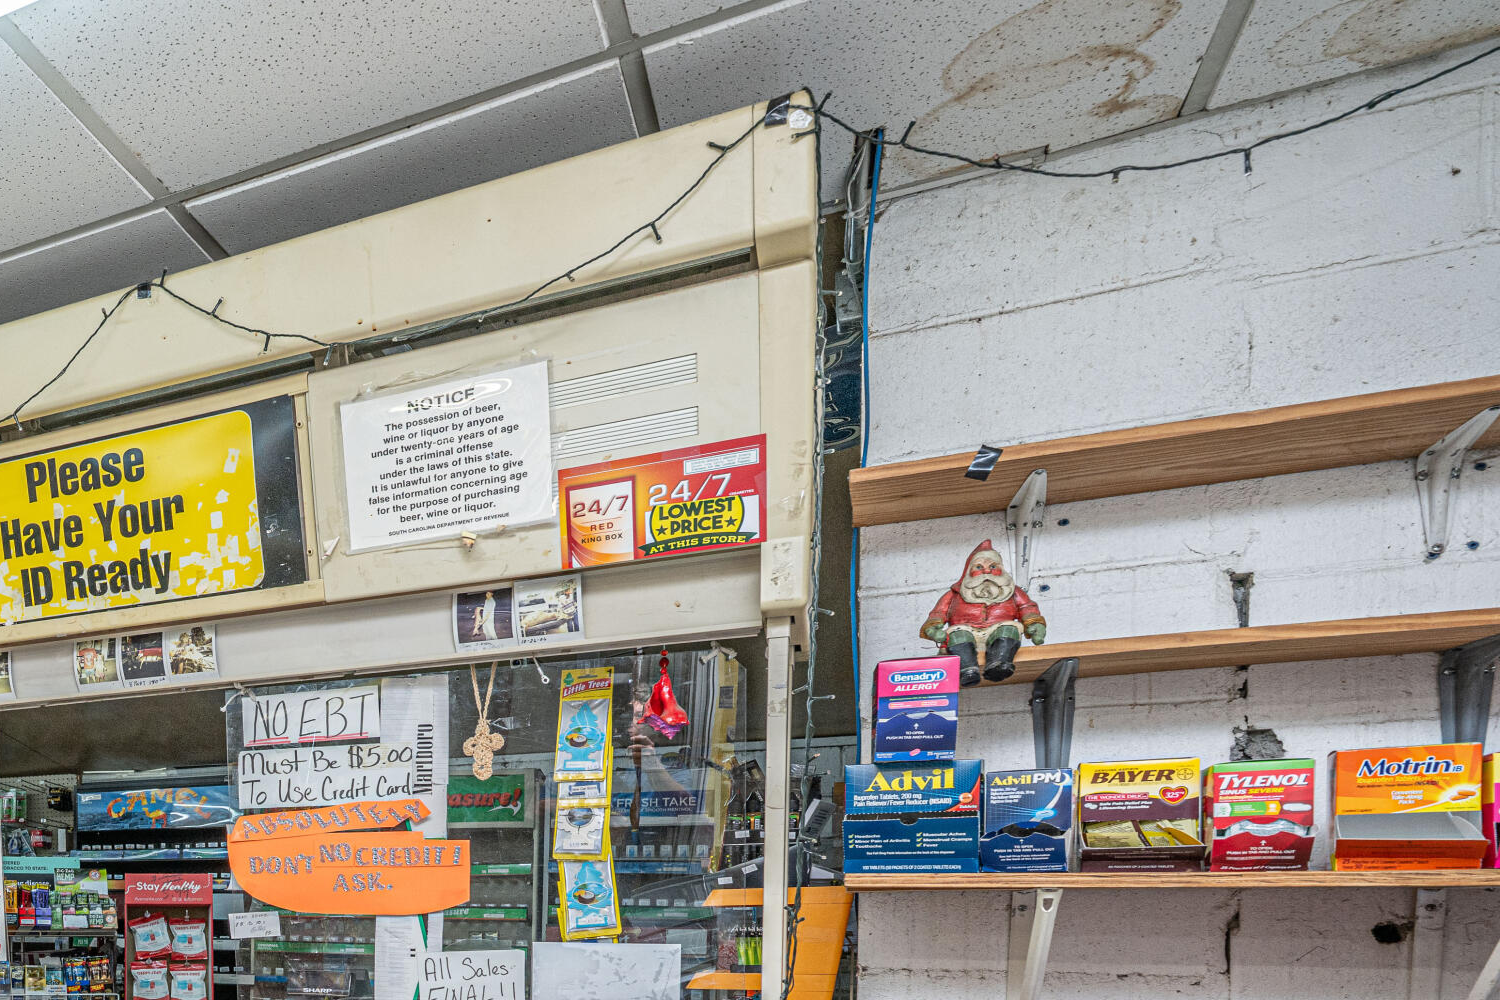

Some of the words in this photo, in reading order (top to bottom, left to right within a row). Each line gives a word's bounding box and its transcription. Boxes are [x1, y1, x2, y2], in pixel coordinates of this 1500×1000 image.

[407, 388, 475, 413] NOTICE
[383, 434, 404, 444] wine
[420, 425, 449, 439] liquor
[452, 422, 464, 431] by
[467, 414, 504, 428] anyone
[385, 423, 403, 432] The
[406, 411, 459, 430] possession
[462, 408, 473, 416] of
[476, 403, 501, 413] beer,
[371, 448, 398, 458] under
[401, 436, 455, 451] twenty-one
[458, 430, 485, 443] years
[488, 425, 498, 435] of
[500, 423, 519, 435] age
[396, 457, 403, 465] is
[414, 448, 453, 462] criminal
[457, 441, 493, 453] offense
[25, 448, 145, 503] Please
[372, 485, 380, 493] It
[381, 484, 388, 492] is
[391, 476, 431, 490] unlawful
[434, 473, 447, 482] for
[450, 467, 487, 481] anyone
[489, 463, 499, 472] to
[503, 459, 524, 472] give
[380, 470, 407, 480] under
[410, 466, 424, 475] the
[428, 462, 448, 471] laws
[452, 458, 462, 467] of
[465, 454, 482, 464] this
[485, 451, 512, 460] state.
[369, 495, 390, 505] false
[392, 485, 448, 501] information
[451, 475, 507, 491] concerning
[509, 471, 528, 481] age
[377, 507, 390, 516] for
[392, 503, 407, 512] the
[410, 496, 449, 512] purpose
[452, 494, 461, 503] of
[464, 484, 520, 502] purchasing
[648, 472, 732, 506] 24/7
[400, 512, 423, 523] beer,
[426, 508, 449, 518] wine
[465, 501, 496, 514] liquor.
[572, 495, 629, 519] 24/7
[658, 496, 735, 521] LOWEST
[0, 514, 83, 560] Have
[94, 494, 184, 542] Your
[408, 525, 436, 534] CAROLINA
[437, 518, 473, 529] DEPARTMENT
[484, 512, 510, 521] REVENUE
[590, 522, 614, 532] RED
[670, 514, 723, 535] PRICE
[581, 534, 602, 544] KING
[605, 532, 623, 541] BOX
[650, 544, 664, 554] AT
[668, 538, 698, 550] THIS
[702, 534, 746, 545] STORE
[21, 566, 54, 607] ID
[63, 548, 171, 601] Ready
[894, 672, 940, 682] Benadryl
[894, 683, 939, 692] ALLERGY
[253, 700, 288, 743] NO
[300, 692, 374, 738] EBT
[242, 750, 308, 775] Must
[313, 750, 340, 772] Be
[348, 746, 413, 769] $5.00
[1357, 756, 1452, 777] Motrin
[242, 779, 267, 805] To
[279, 778, 317, 803] Use
[322, 776, 371, 800] Credit
[376, 772, 412, 797] Card
[865, 768, 955, 792] Advil
[990, 775, 1032, 786] Advil
[1032, 773, 1061, 784] PM
[1091, 769, 1175, 784] BAYER
[1219, 774, 1310, 790] TYLENOL
[106, 787, 212, 819] CAMEL
[617, 798, 658, 807] FRSH
[662, 797, 696, 806] TAKE
[242, 800, 421, 839] ABSOLUTELY
[319, 842, 352, 864] NO
[136, 881, 159, 893] Stay
[161, 881, 201, 893] Healthy
[332, 872, 393, 892] ASK.
[424, 958, 451, 982] All
[461, 957, 510, 981] Sales
